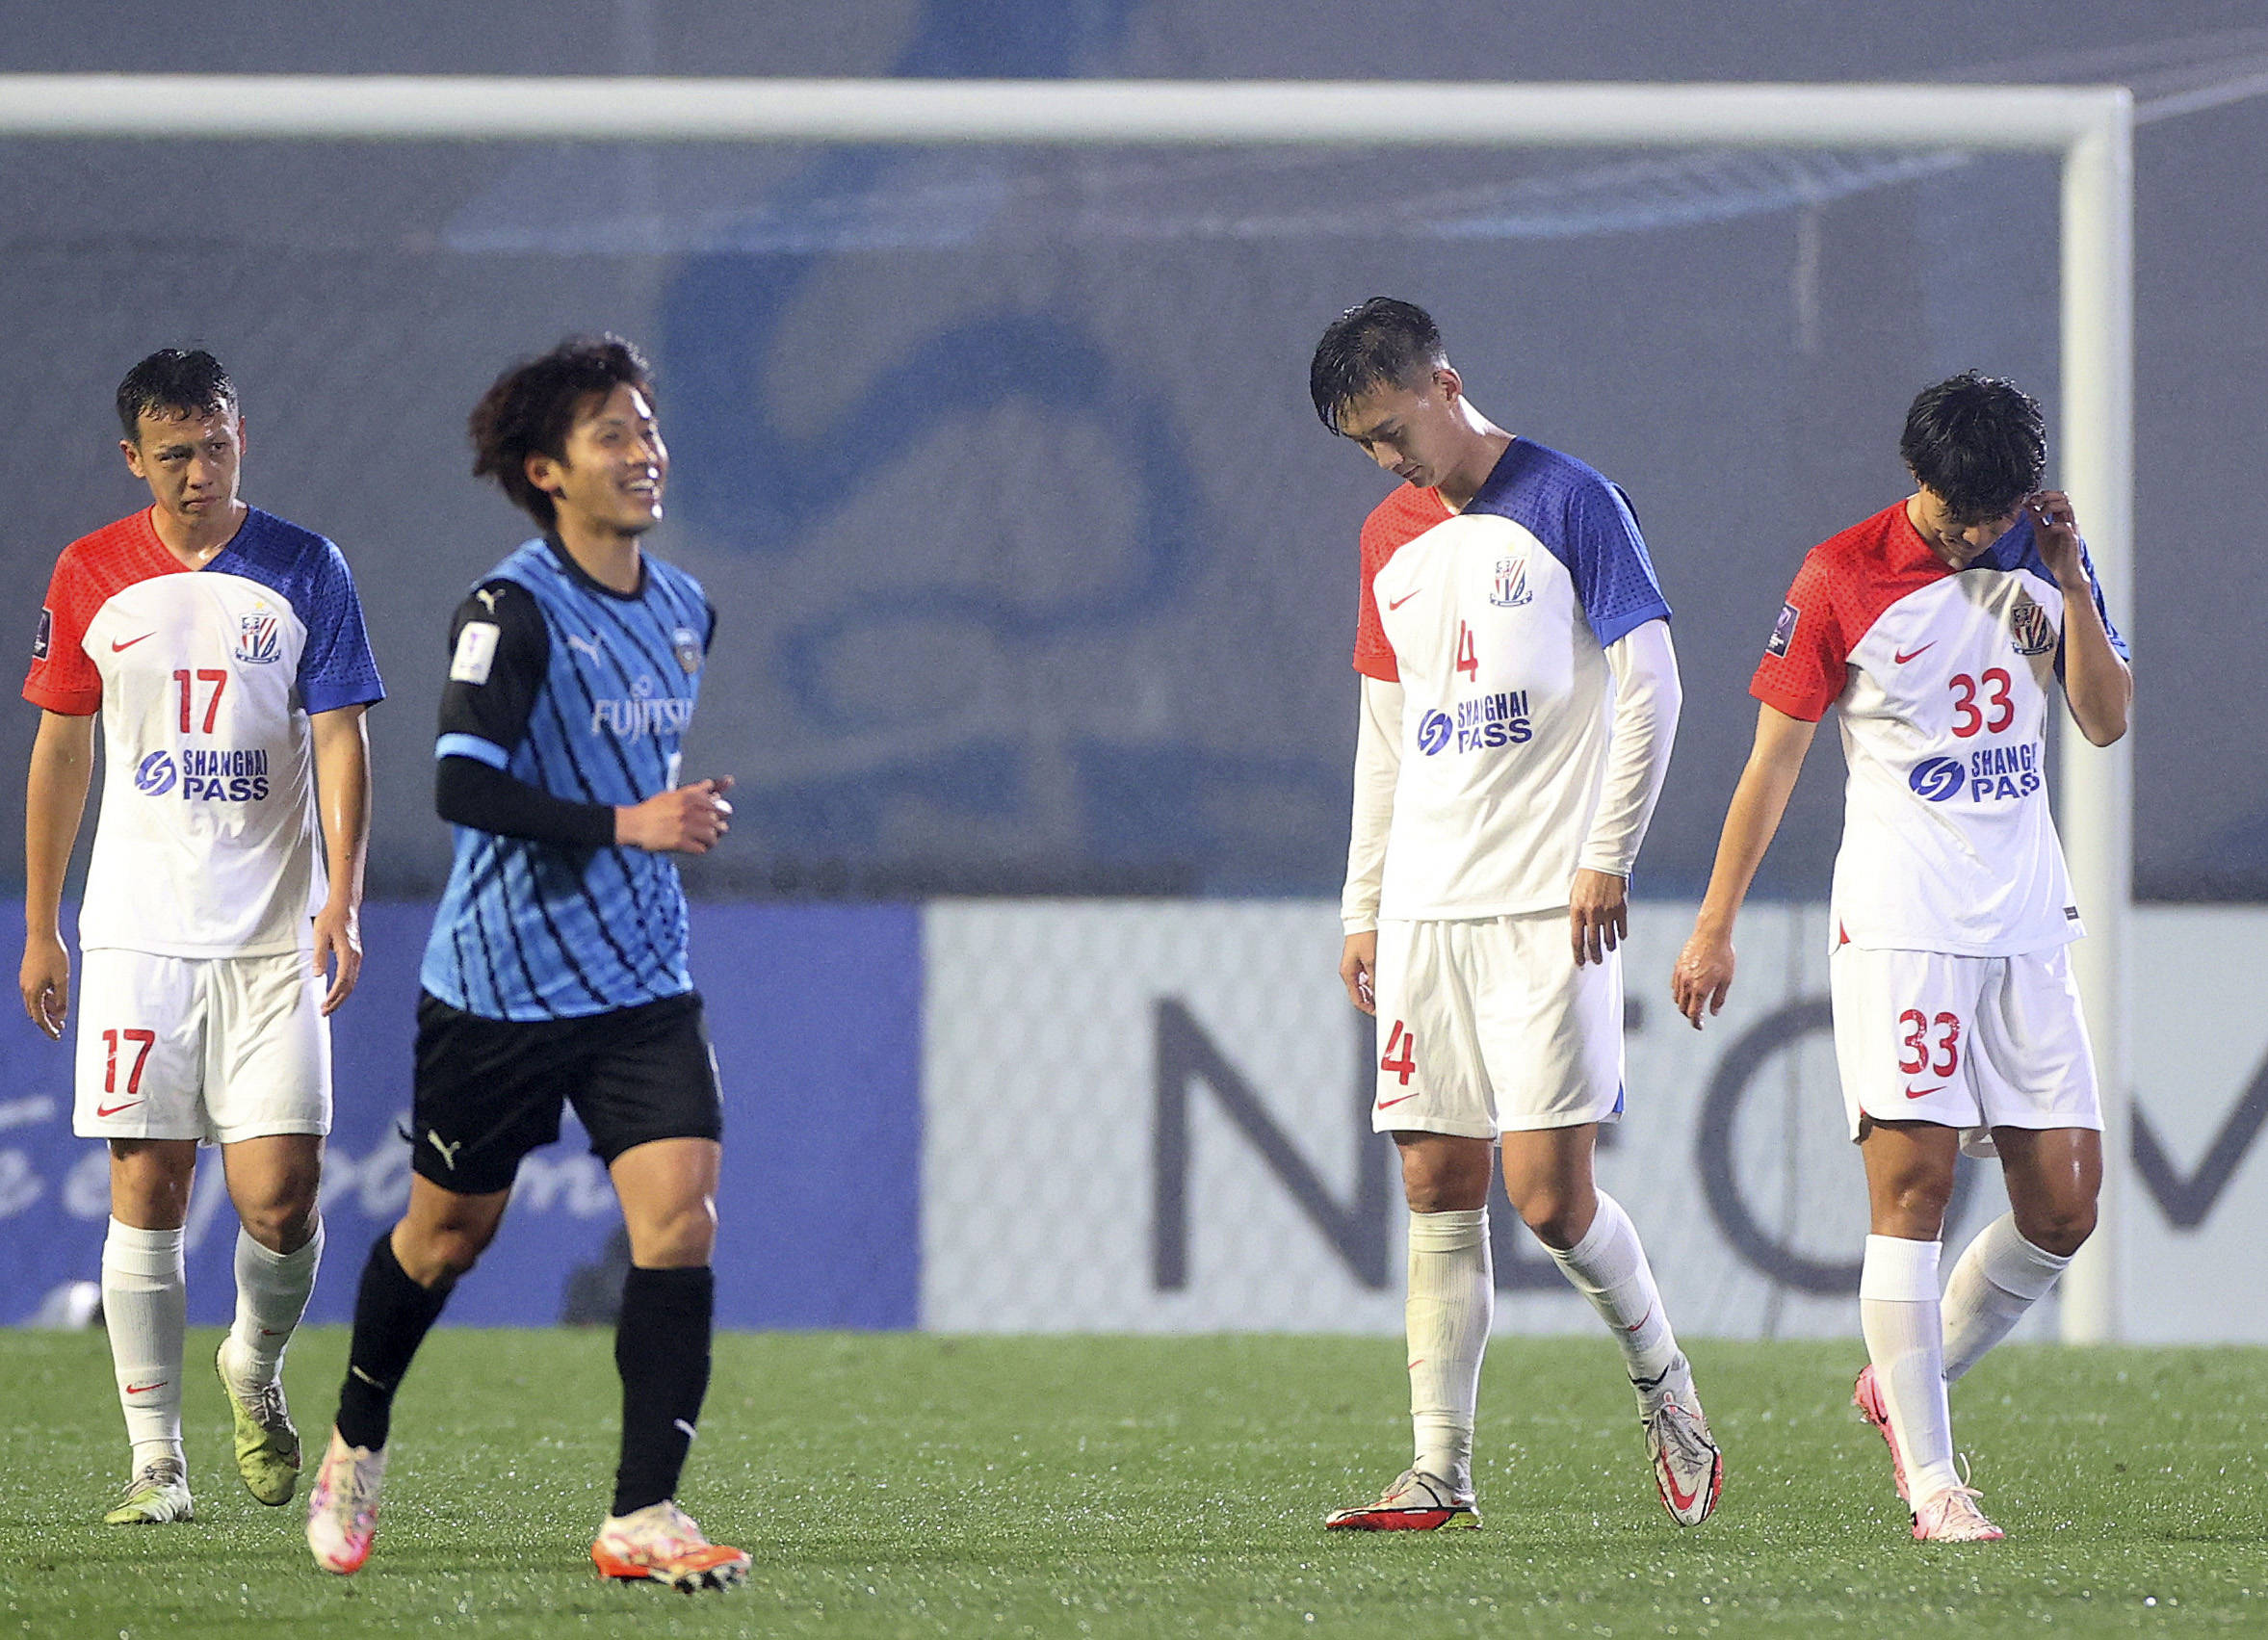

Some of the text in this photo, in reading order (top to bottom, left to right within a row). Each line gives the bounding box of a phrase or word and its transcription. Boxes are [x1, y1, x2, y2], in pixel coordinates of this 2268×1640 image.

[1456, 619, 1478, 682] 4
[172, 668, 227, 734] 17
[1948, 667, 2015, 738] 33
[183, 748, 268, 777] SHANGHAI
[1457, 718, 1533, 754] PASS
[183, 776, 270, 802] PASS
[102, 1028, 155, 1094] 17
[1380, 1019, 1416, 1086] 4
[1898, 1008, 1961, 1078] 33
